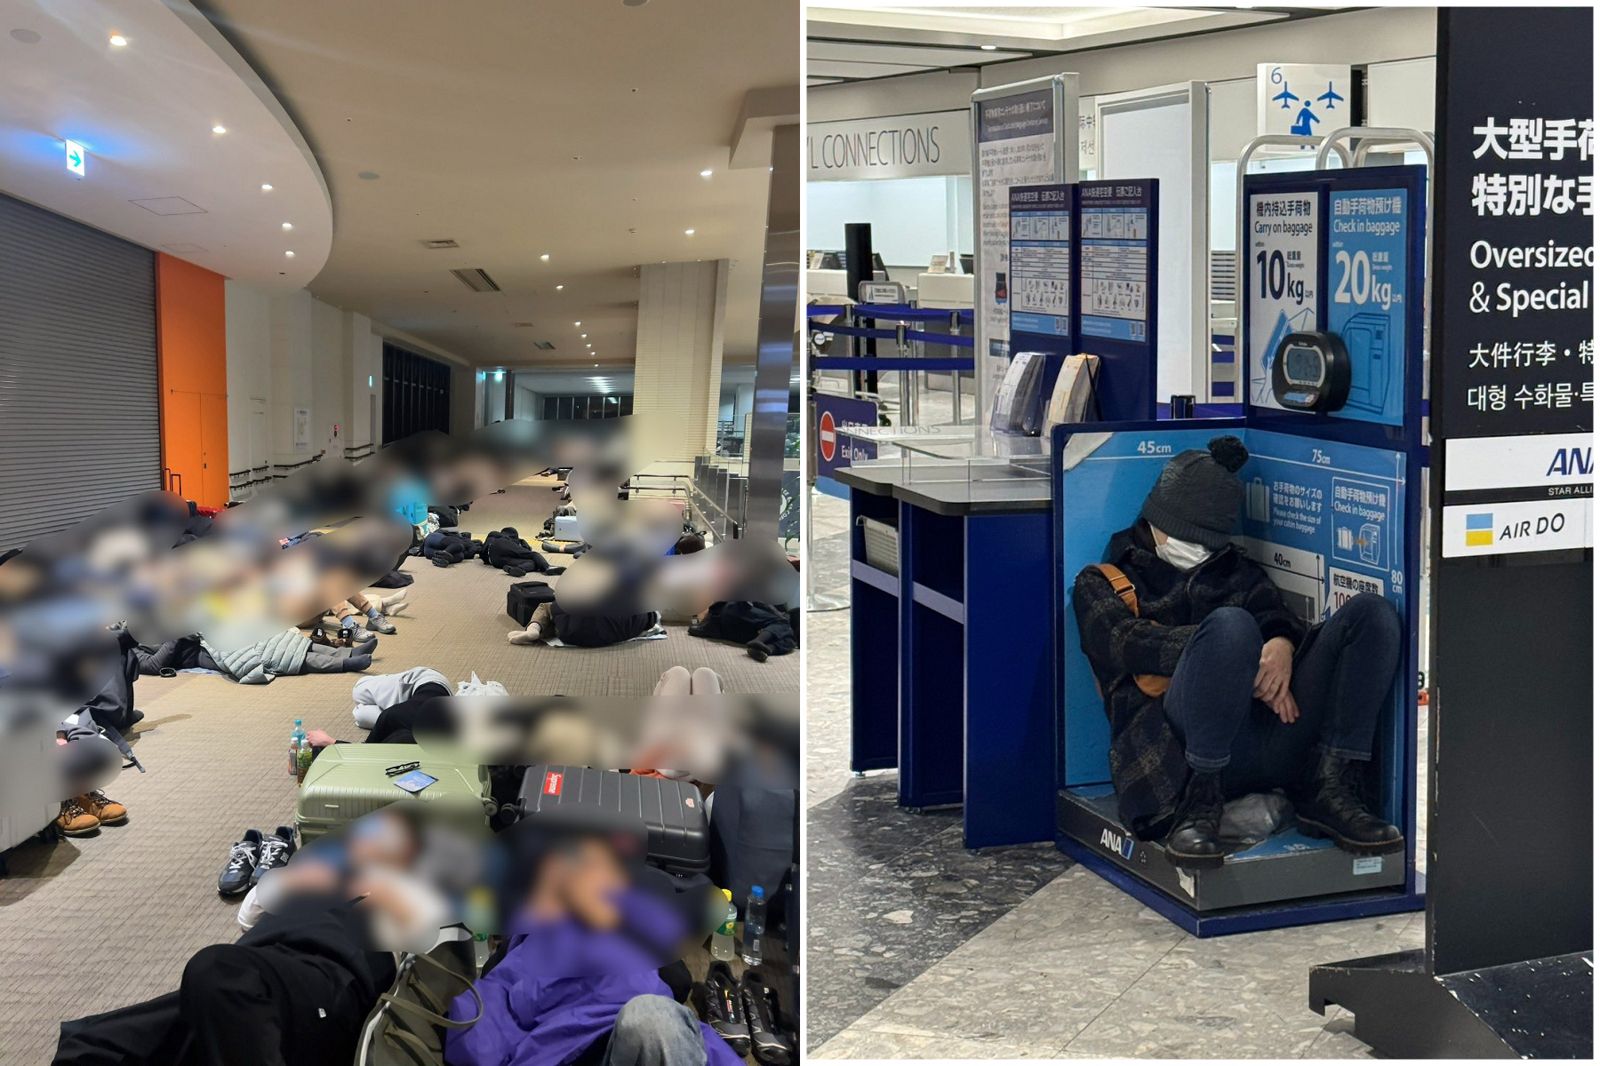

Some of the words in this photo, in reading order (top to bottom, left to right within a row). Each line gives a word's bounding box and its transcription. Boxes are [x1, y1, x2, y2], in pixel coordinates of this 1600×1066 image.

[1271, 67, 1283, 84] 6
[822, 126, 940, 168] CONNECTIONS
[1256, 200, 1311, 217] 機内持込手荷物
[1334, 196, 1402, 215] 自動手荷物預け機
[1255, 220, 1271, 236] Carry
[1272, 223, 1282, 233] on
[1283, 219, 1313, 236] baggage
[1334, 219, 1356, 233] Check
[1357, 220, 1364, 232] in
[1365, 219, 1400, 236] baggage
[1469, 281, 1490, 313] &
[1496, 280, 1588, 318] Special
[1467, 385, 1506, 411] 대형
[1137, 441, 1172, 454] 45cm
[1311, 449, 1330, 465] 75cm
[1548, 487, 1572, 496] STAR
[1334, 500, 1351, 513] Check
[1359, 504, 1386, 522] baggage
[1499, 520, 1531, 541] AIR
[1536, 512, 1565, 535] DO
[1274, 552, 1292, 568] 40cm
[1391, 569, 1403, 585] 80
[1392, 585, 1402, 594] cm
[1100, 828, 1122, 856] ANA
